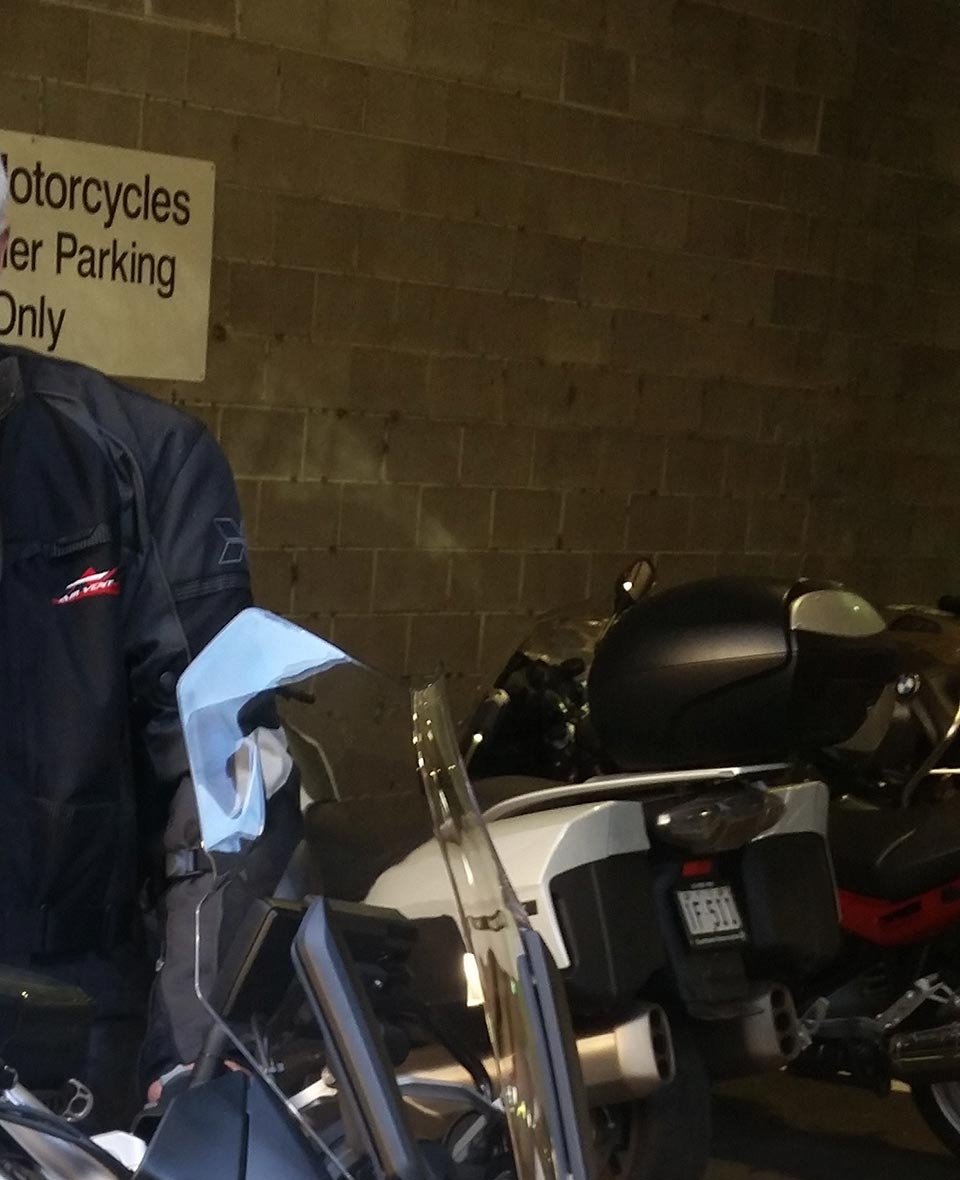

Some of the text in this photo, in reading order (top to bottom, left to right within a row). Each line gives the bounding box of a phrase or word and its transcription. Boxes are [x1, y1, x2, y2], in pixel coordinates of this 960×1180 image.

[1, 154, 191, 229] otorcycles
[2, 231, 176, 299] er Parking
